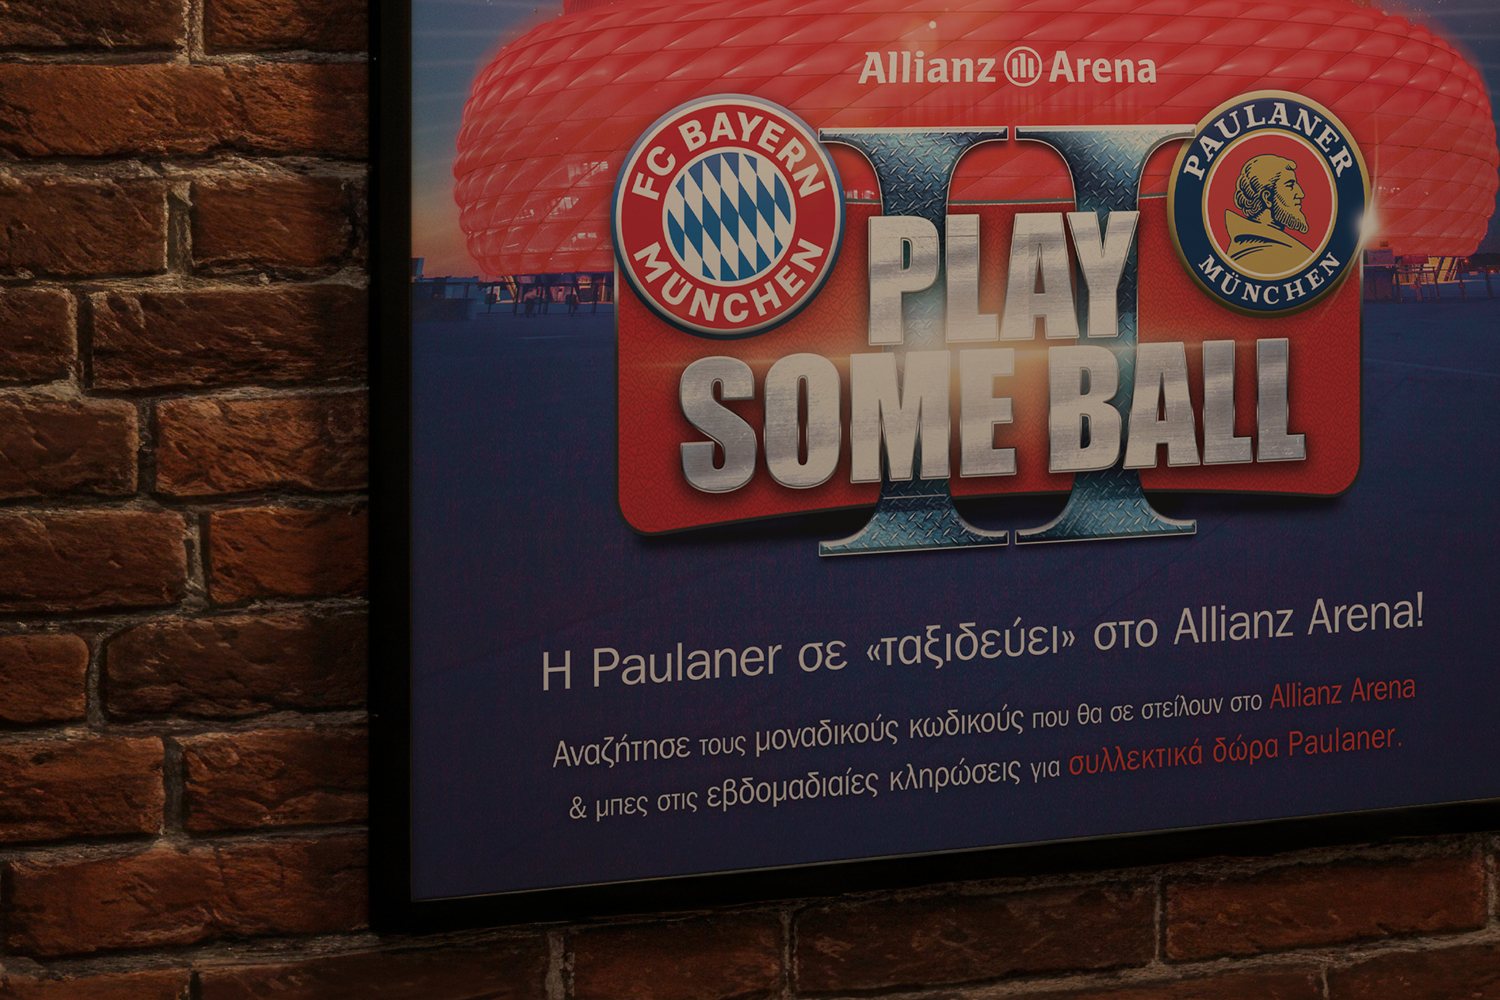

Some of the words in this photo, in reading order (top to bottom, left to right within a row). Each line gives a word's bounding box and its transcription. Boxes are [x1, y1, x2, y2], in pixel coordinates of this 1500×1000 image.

[858, 50, 996, 84] Allianz
[1049, 50, 1157, 83] Arena
[631, 145, 676, 201] FC
[678, 111, 826, 198] BAYERN
[1183, 102, 1353, 181] PAULANER
[633, 238, 824, 323] MÜNCHEN
[868, 210, 1140, 345] PLAY
[1198, 252, 1341, 305] MÜNCHEN
[679, 348, 1017, 493] SOME
[1048, 338, 1306, 474] BALL
[542, 649, 571, 691] Η
[593, 642, 783, 688] Paulaner
[798, 640, 848, 673] σε
[866, 616, 1076, 670] «ταξιδεύει»
[1093, 618, 1159, 651] στο
[1173, 605, 1294, 645] Allianz
[1307, 591, 1424, 635] Arena!
[552, 733, 691, 769] Αναζήτησε
[698, 735, 747, 757] τους
[755, 713, 899, 758] μοναδικούς
[909, 703, 1025, 739] κωδικούς
[1032, 709, 1070, 729] που
[1077, 703, 1102, 725] θα
[1110, 704, 1134, 723] σε
[1141, 694, 1224, 720] στείλουν
[1230, 691, 1263, 712] στο
[1269, 681, 1343, 709] Allianz
[1350, 677, 1416, 703] Arena
[569, 795, 587, 820] &
[596, 795, 649, 822] μπες
[657, 791, 699, 813] στις
[706, 766, 879, 812] εβδομαδιαίες
[890, 757, 1021, 794] κληρώσεις
[1030, 760, 1061, 784] για
[1069, 737, 1203, 776] συλλεκτικά
[1212, 733, 1279, 766] δώρα
[1289, 725, 1402, 757] Paulaner.
